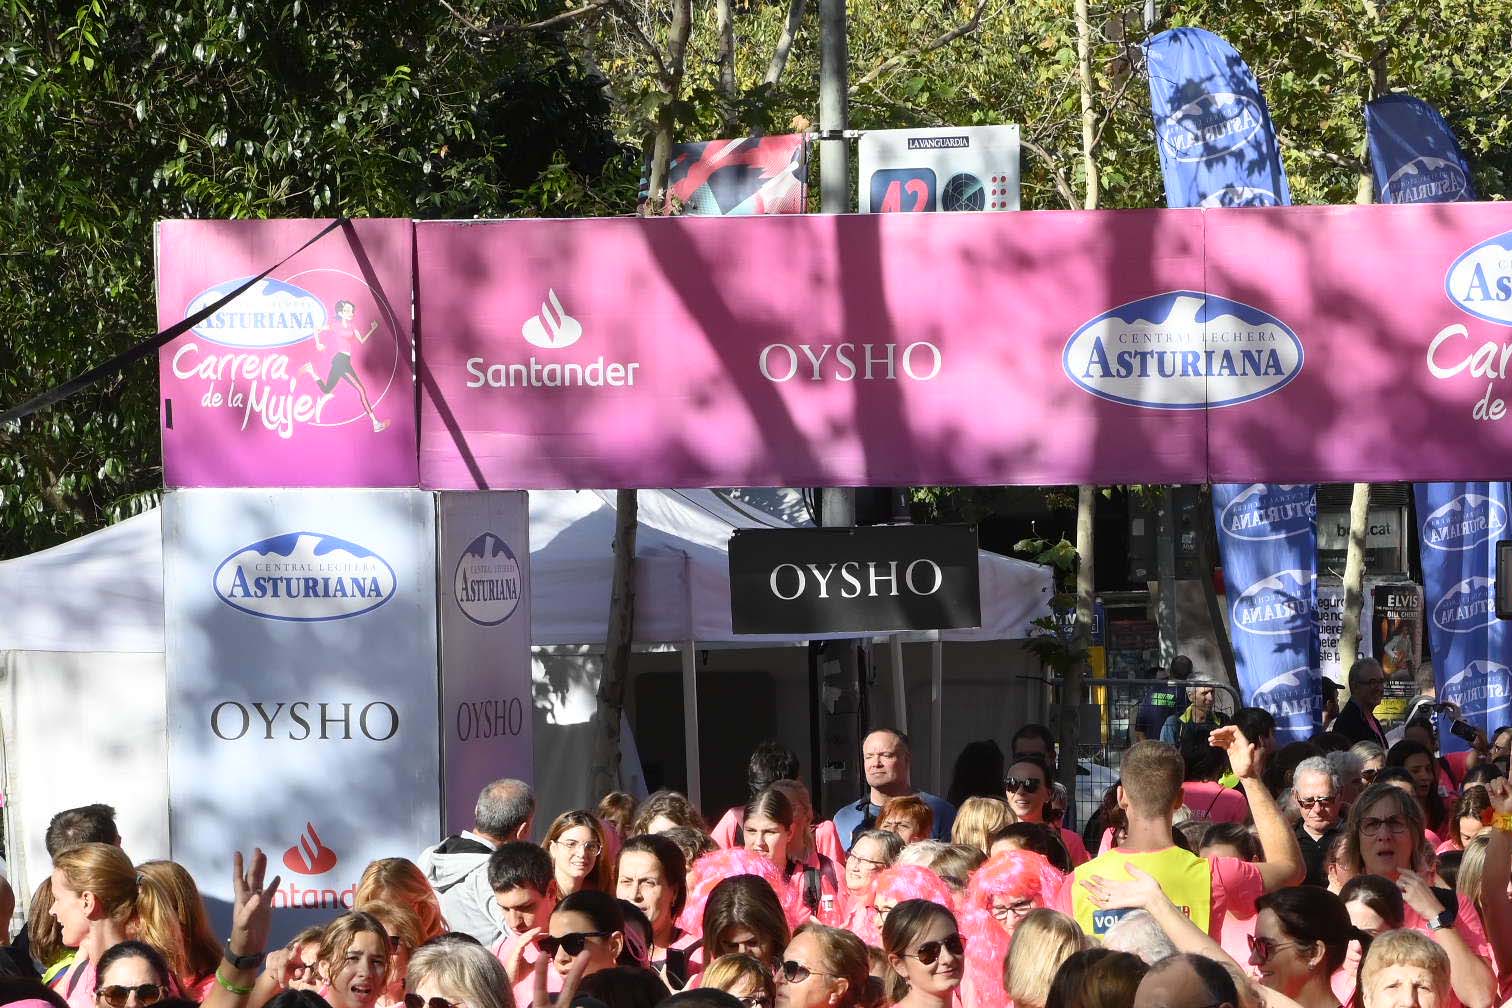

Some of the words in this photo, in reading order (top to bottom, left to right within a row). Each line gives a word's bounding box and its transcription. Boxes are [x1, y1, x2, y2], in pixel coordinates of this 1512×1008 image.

[1119, 332, 1192, 344] CENTRAL
[1201, 331, 1277, 342] LECHERA
[172, 342, 290, 380] Carrera
[466, 357, 640, 388] Santander
[759, 340, 943, 383] OYSHO
[1082, 335, 1286, 379] ASTURIANA
[201, 382, 223, 408] de
[227, 379, 244, 408] la
[241, 376, 335, 439] Mujer
[1472, 382, 1507, 421] de
[1336, 523, 1392, 537] b.cat
[227, 565, 384, 600] ASTURIANA
[255, 563, 313, 572] CENTRAL
[460, 566, 518, 602] ASTURIANA
[769, 557, 944, 601] OYSHO
[1387, 594, 1419, 608] ELVIS
[210, 701, 400, 742] OYSHO
[457, 697, 523, 742] OYSHO
[271, 883, 357, 909] ntand
[1094, 914, 1120, 929] VOL
